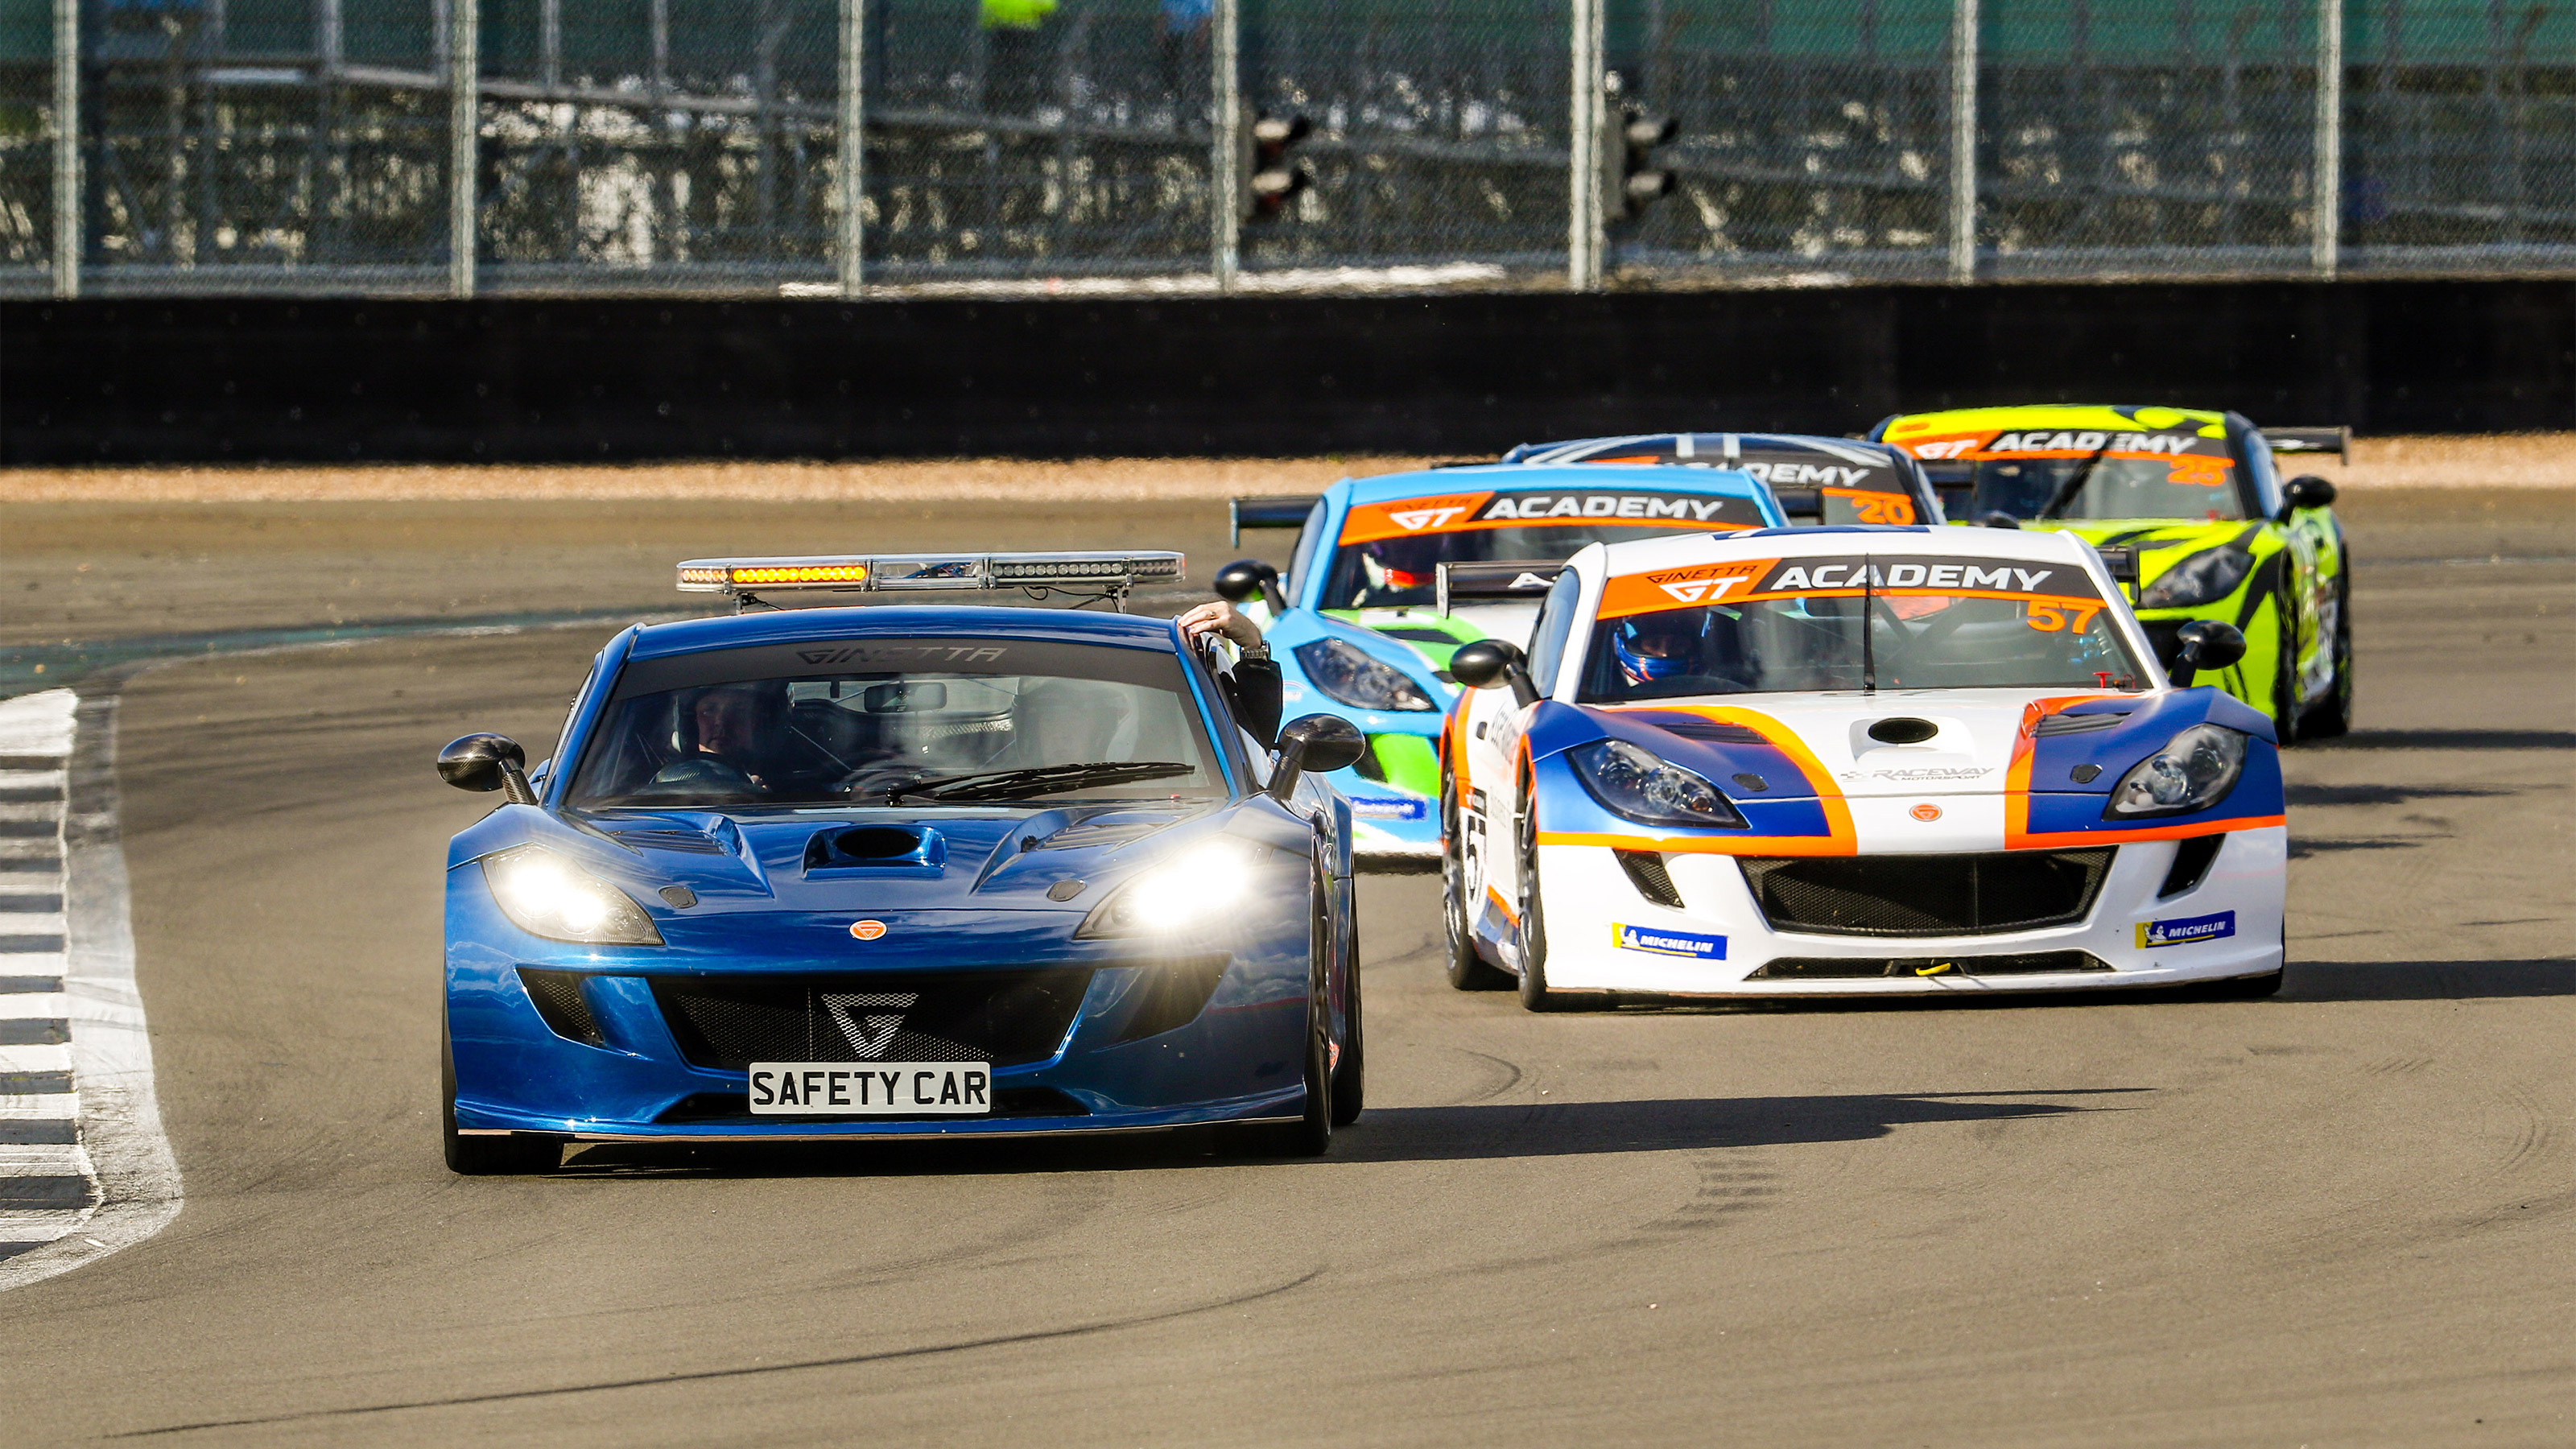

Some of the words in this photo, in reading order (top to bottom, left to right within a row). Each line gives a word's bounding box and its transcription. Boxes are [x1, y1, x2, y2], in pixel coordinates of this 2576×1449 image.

[1989, 431, 2198, 456] ACADEMY
[2168, 459, 2227, 487] 25
[1389, 506, 1466, 530] GT
[1482, 496, 1724, 521] ACADEMY
[1851, 496, 1917, 526] 20
[1646, 564, 1759, 584] GINETTA
[1658, 576, 1749, 602] GT
[1770, 564, 2053, 592] ACADEMY
[2027, 601, 2100, 634] 57
[795, 646, 1008, 665] GINETTA
[1872, 767, 1996, 781] RACEWAY
[2169, 921, 2226, 938] MICHELIN
[1640, 935, 1714, 953] MICHELIN
[752, 1071, 901, 1105] SAFETY
[914, 1071, 987, 1104] CAR
